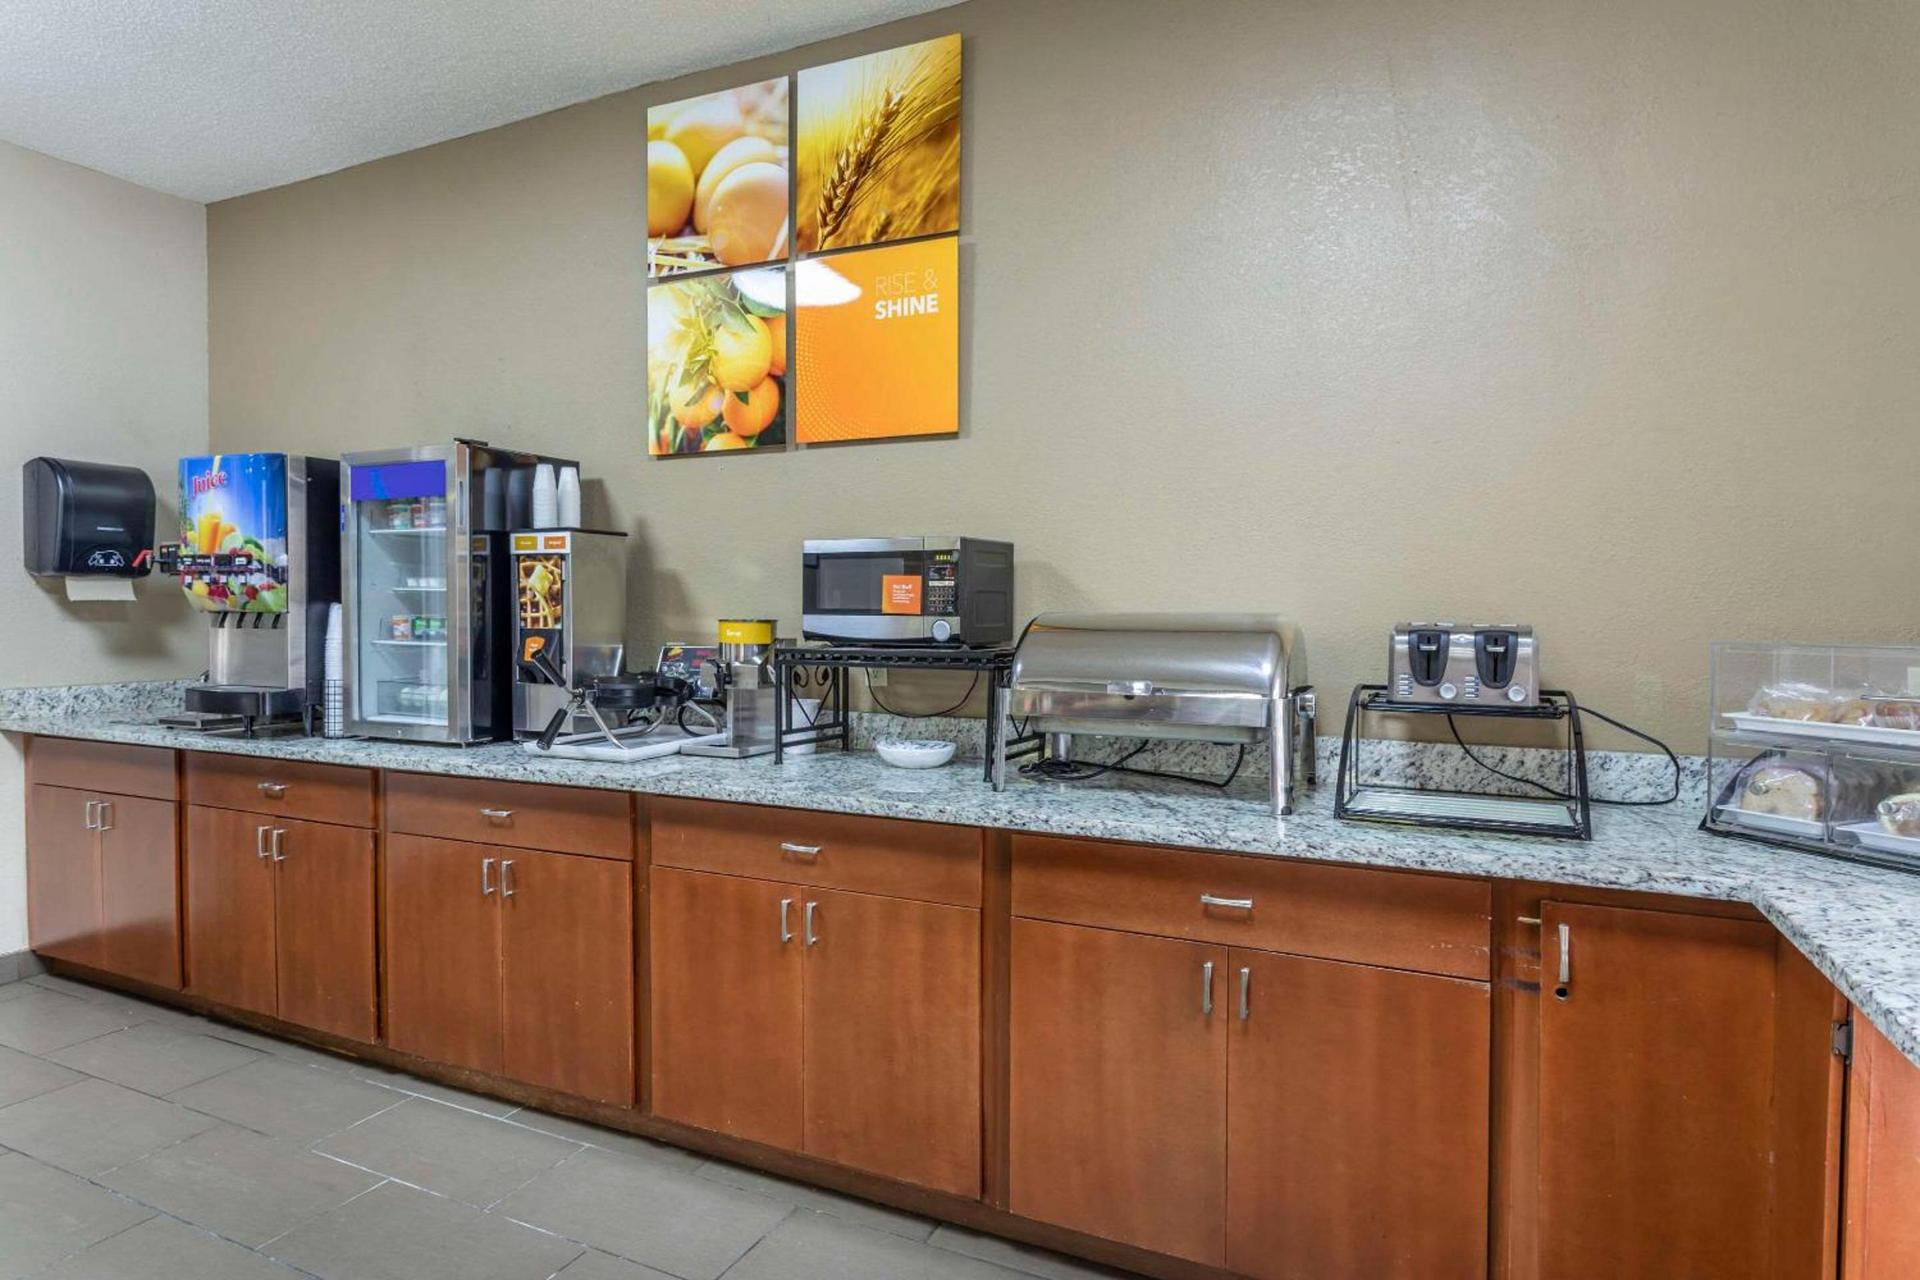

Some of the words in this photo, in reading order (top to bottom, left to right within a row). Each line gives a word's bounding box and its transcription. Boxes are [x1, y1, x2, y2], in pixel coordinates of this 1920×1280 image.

[876, 271, 915, 294] RISE
[922, 269, 938, 292] &
[875, 293, 939, 320] SHINE
[192, 471, 227, 497] Juice
